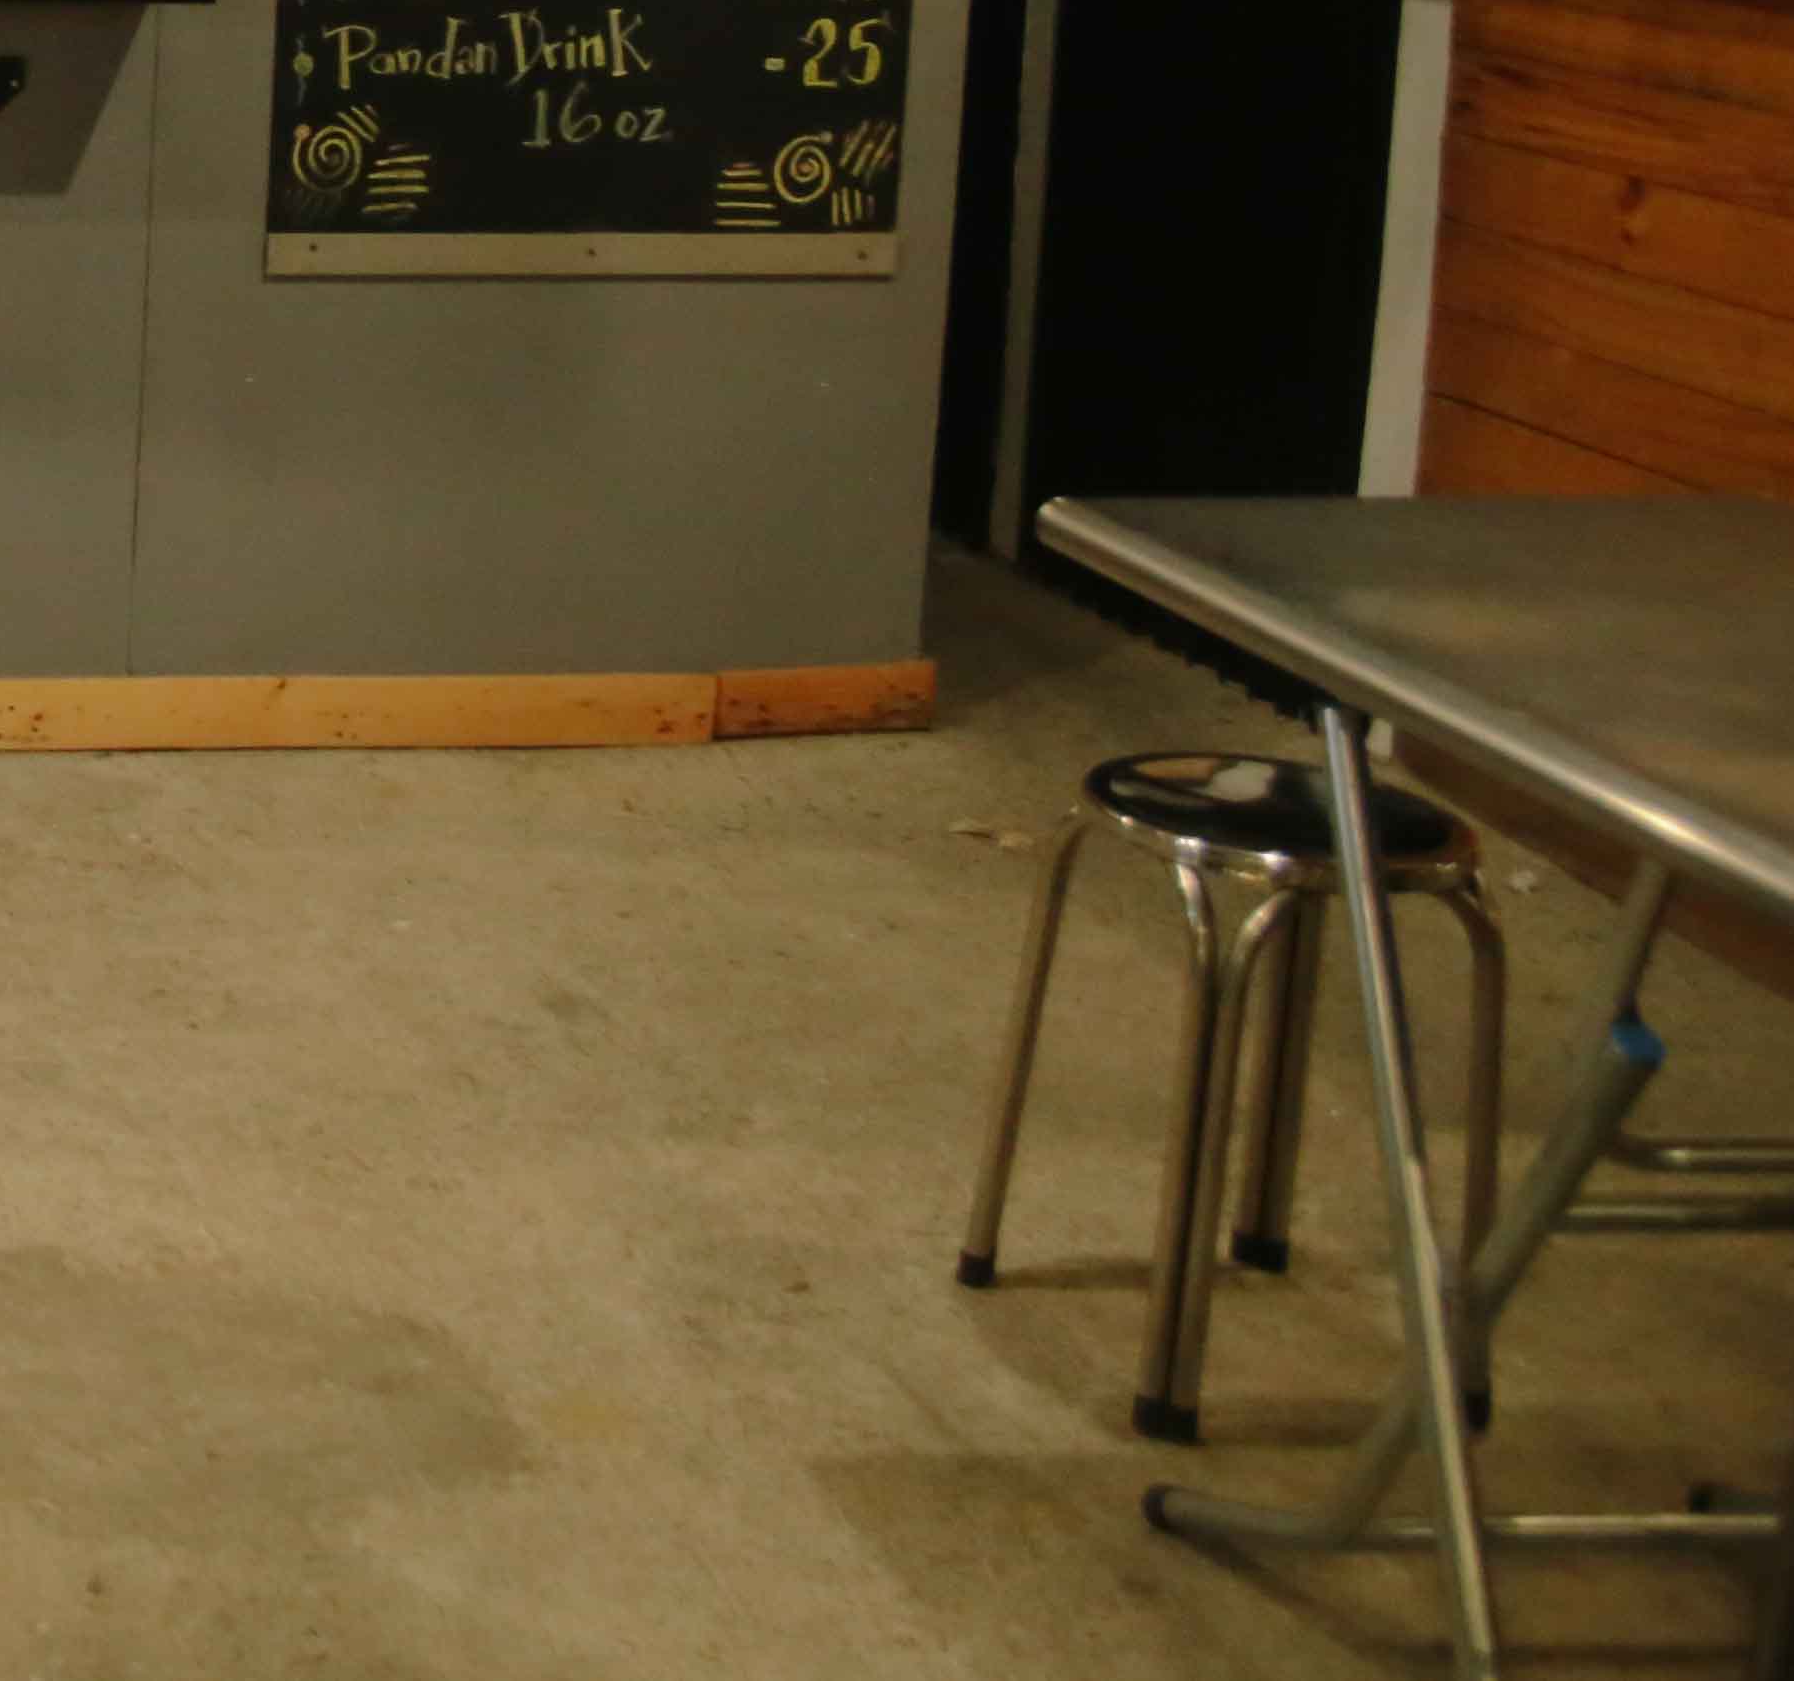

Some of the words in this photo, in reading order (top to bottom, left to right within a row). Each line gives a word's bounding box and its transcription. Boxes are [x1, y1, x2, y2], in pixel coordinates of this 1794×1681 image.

[323, 23, 499, 91] Pandan
[802, 17, 893, 88] 25
[522, 82, 603, 149] 16
[615, 107, 669, 143] oz
